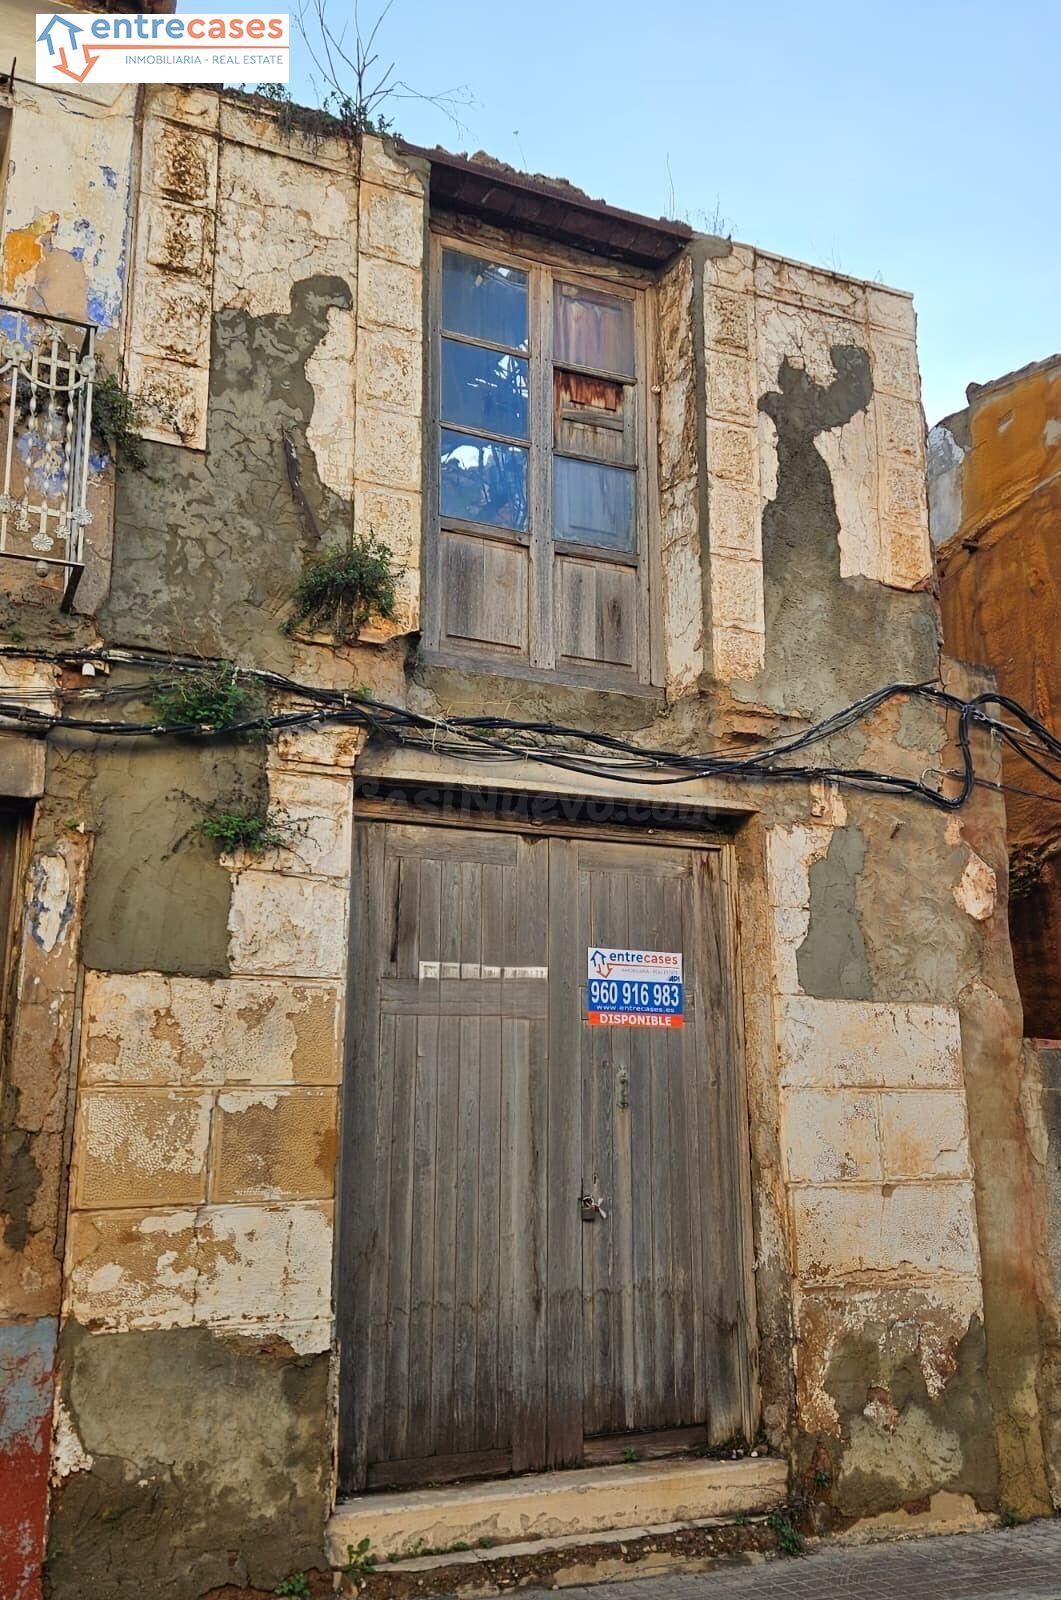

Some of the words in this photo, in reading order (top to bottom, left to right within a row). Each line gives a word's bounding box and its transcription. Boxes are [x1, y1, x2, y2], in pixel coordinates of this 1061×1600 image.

[609, 952, 678, 965] entrecases
[591, 981, 618, 1004] 960
[622, 982, 649, 1006] 916
[653, 984, 679, 1007] 983
[599, 1013, 672, 1026] DISPONIBLE
